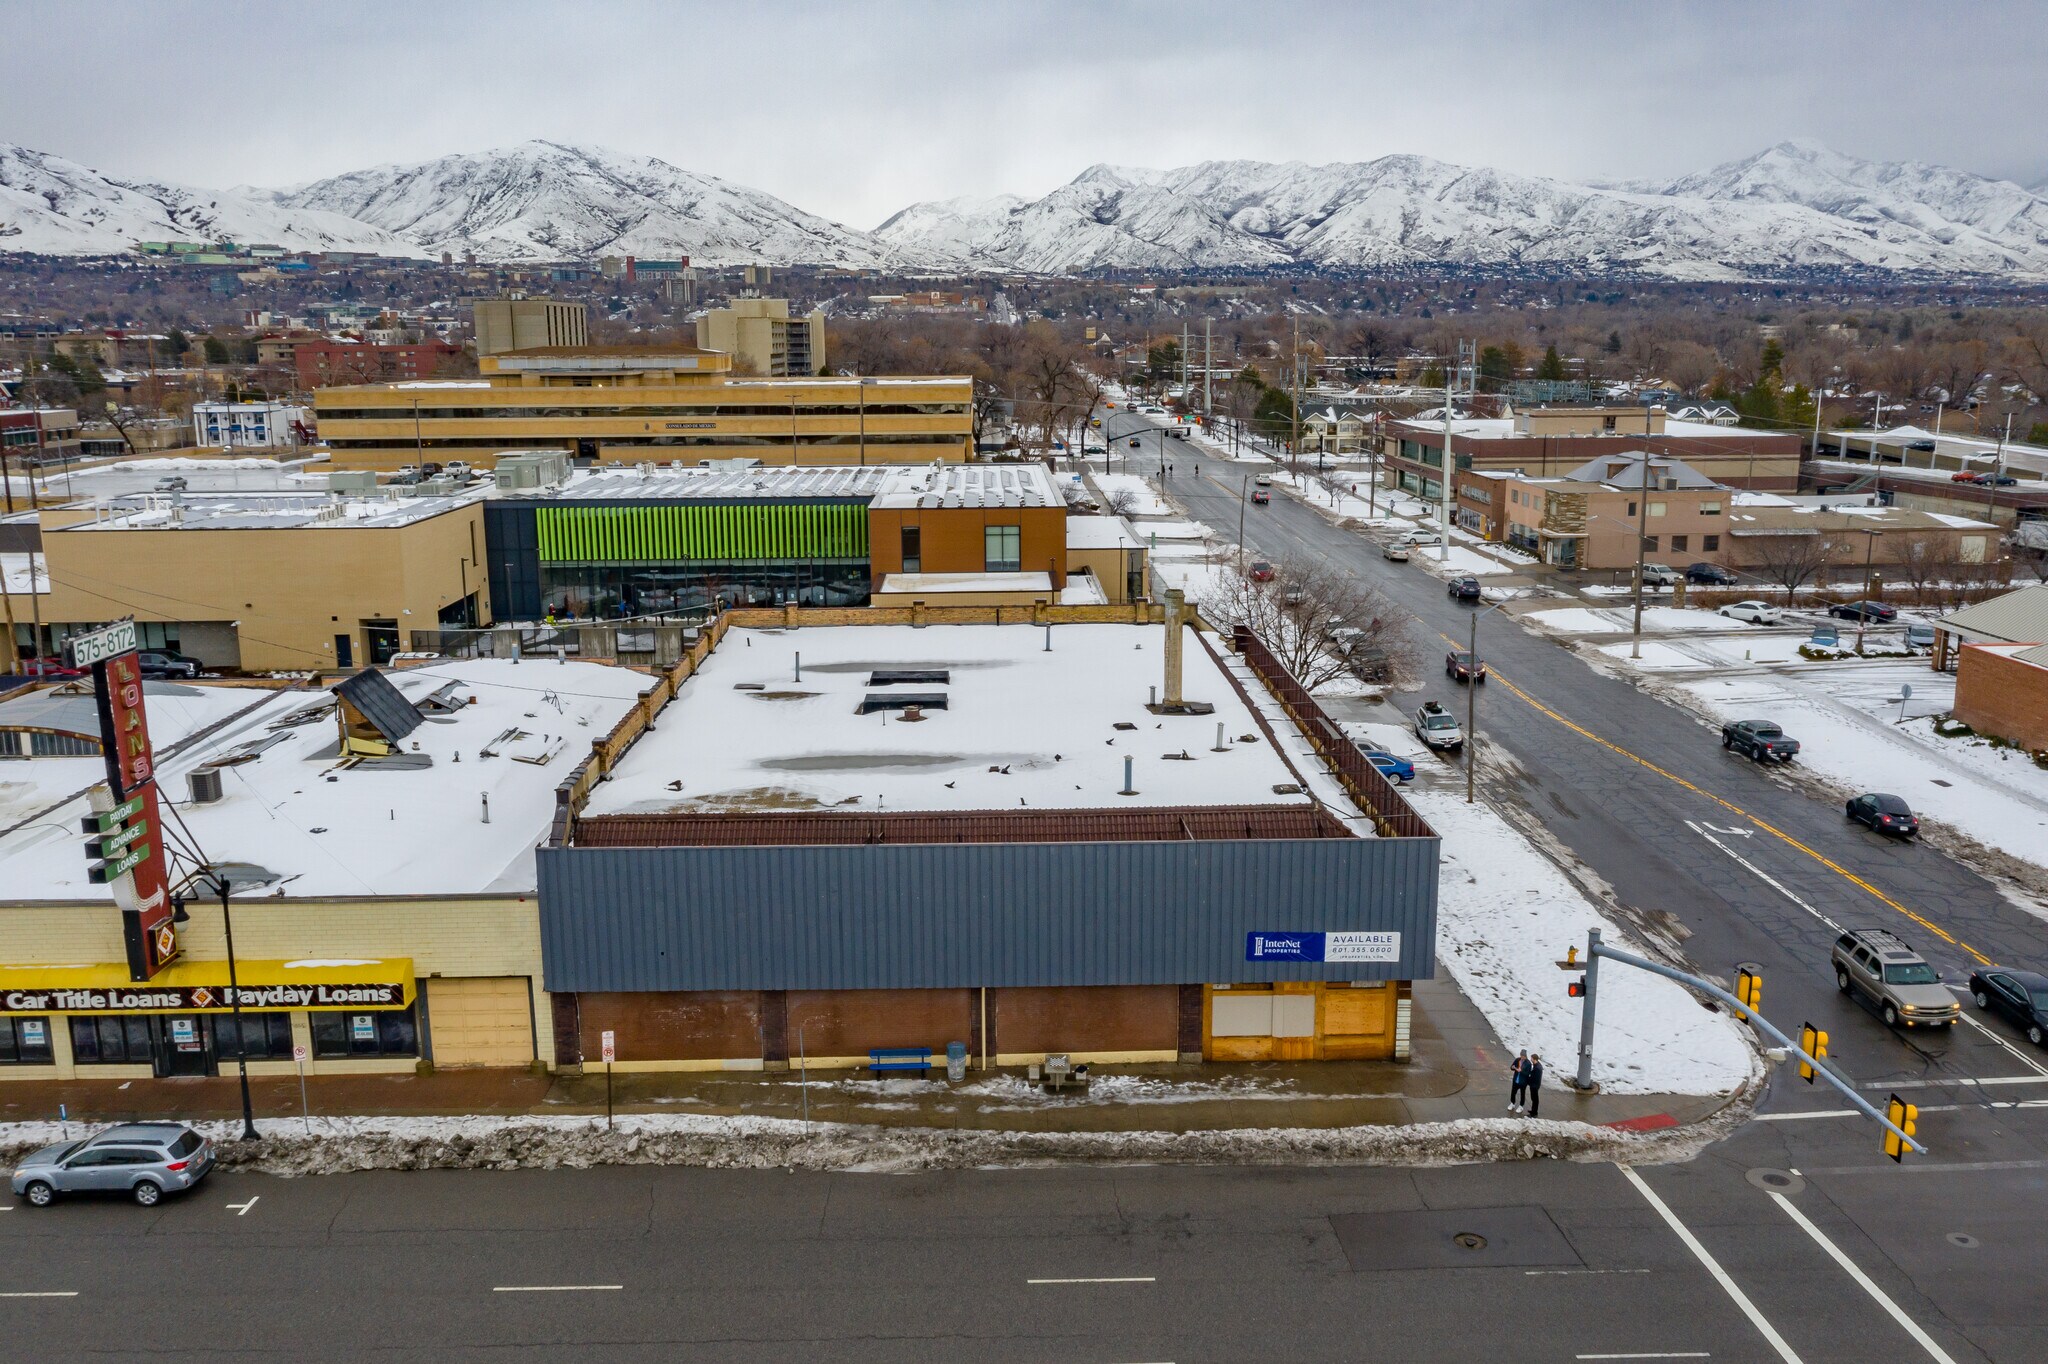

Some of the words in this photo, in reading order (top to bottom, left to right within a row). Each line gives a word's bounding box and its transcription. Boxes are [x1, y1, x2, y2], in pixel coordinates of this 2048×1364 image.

[76, 625, 135, 664] 575-8172
[115, 660, 150, 781] LOANS
[109, 803, 133, 824] PAYDAY
[110, 825, 140, 851] ADVANCE
[117, 852, 139, 873] LOANS
[1265, 940, 1300, 948] InterNet
[1333, 935, 1392, 943] AVAILABLE
[6, 992, 49, 1010] Car
[52, 990, 106, 1009] Title
[109, 991, 182, 1009] Loans
[224, 986, 314, 1007] Payday
[318, 986, 392, 1003] Loans
